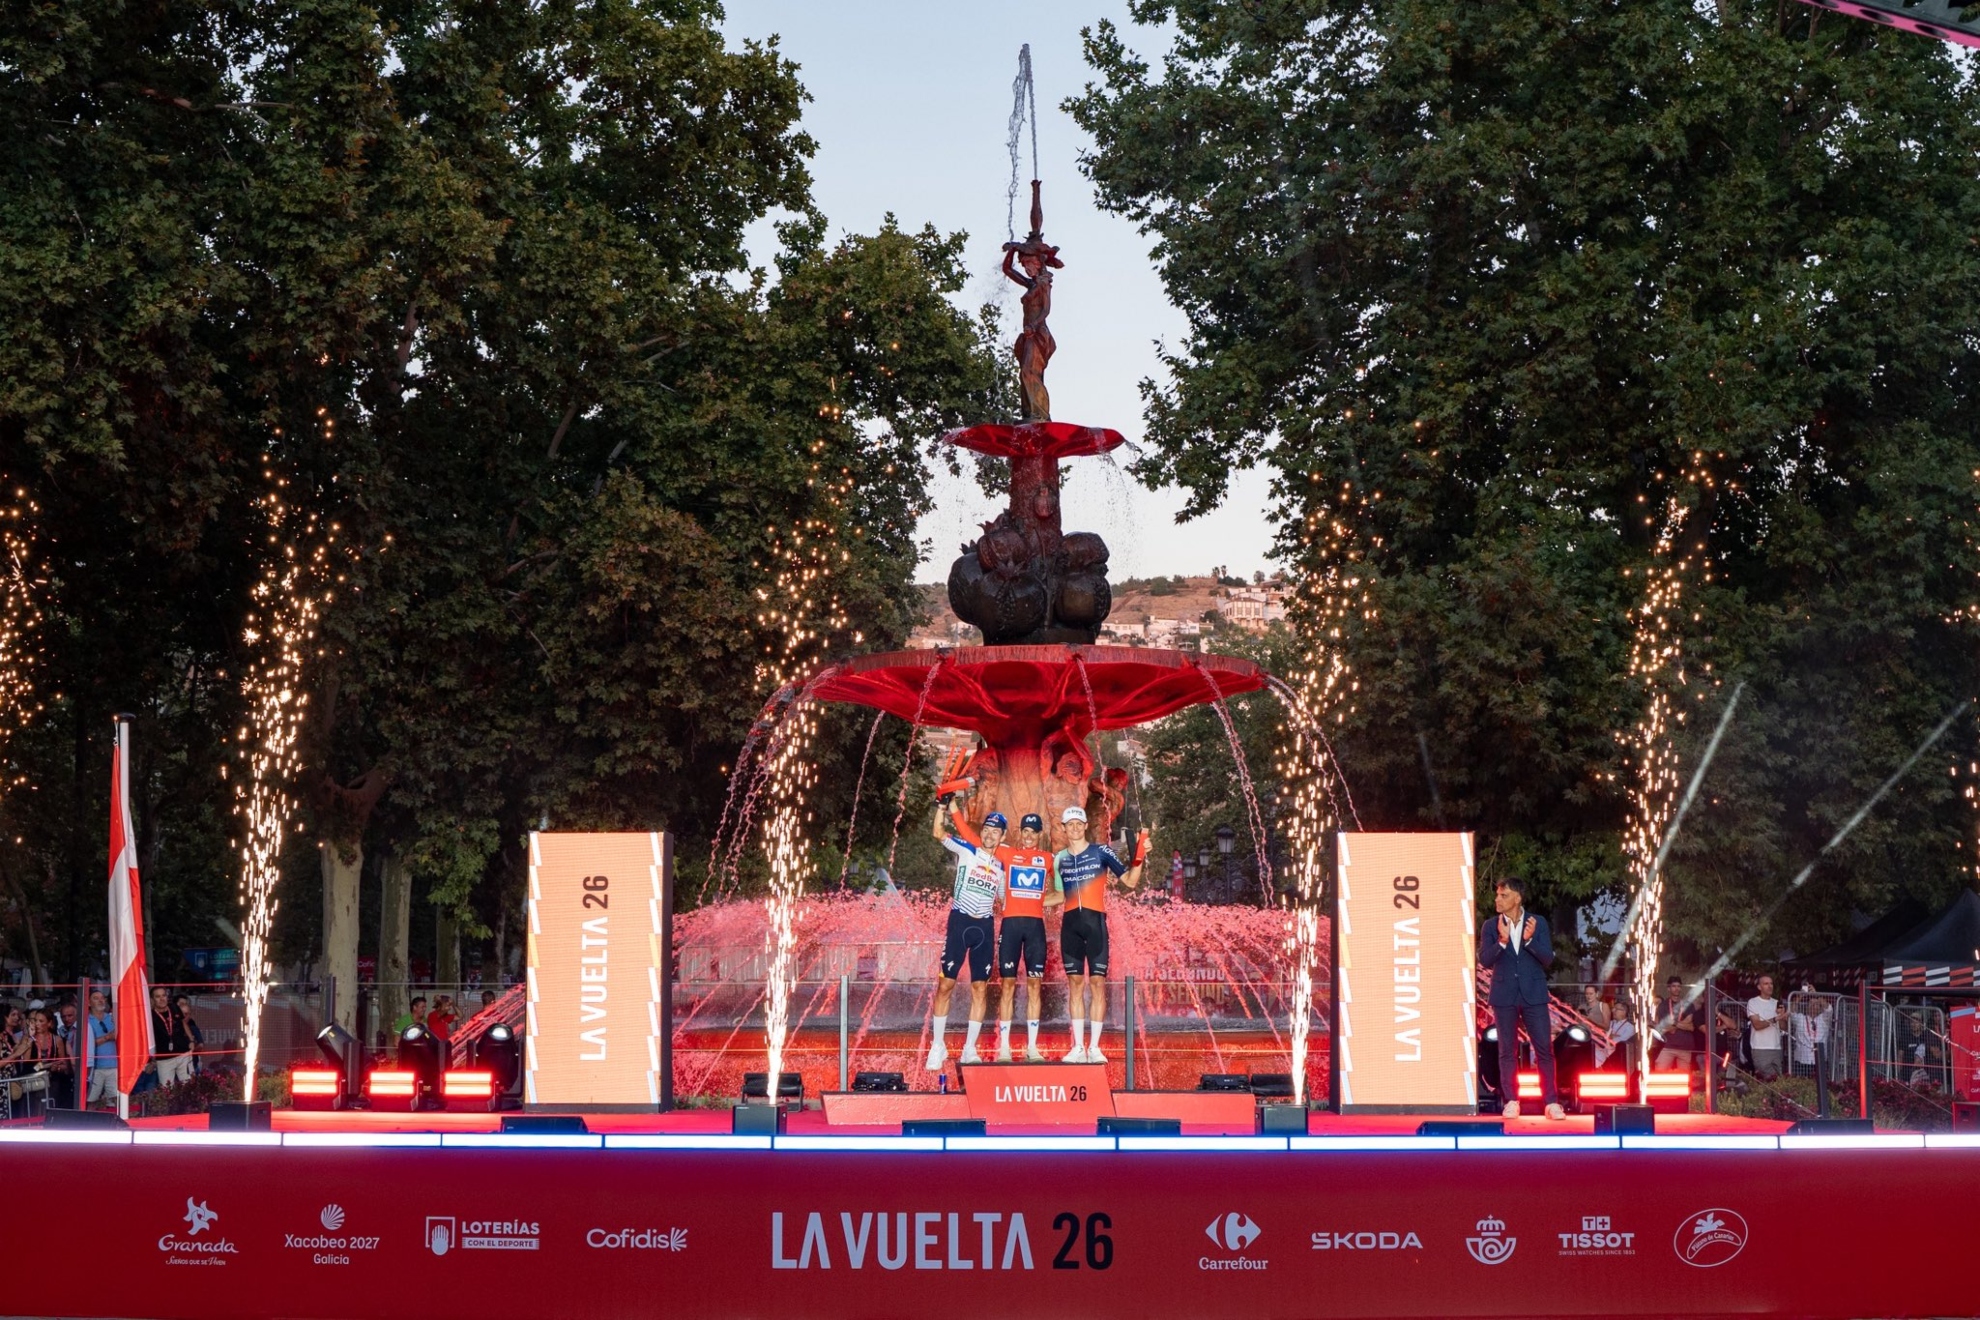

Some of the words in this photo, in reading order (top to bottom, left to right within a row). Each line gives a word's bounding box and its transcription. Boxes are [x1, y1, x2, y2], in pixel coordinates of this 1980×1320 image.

[582, 875, 609, 910] 26
[968, 876, 997, 890] BORA
[1393, 875, 1420, 910] 26
[579, 916, 609, 1023] VUELTA
[1393, 916, 1422, 1024] VUELTA
[579, 1027, 607, 1061] LA
[1394, 1027, 1422, 1062] LA
[995, 1085, 1012, 1102] LA
[1014, 1085, 1067, 1102] VUELTA
[1070, 1085, 1087, 1102] 26
[461, 1219, 540, 1236] LOTERÍAS
[158, 1233, 239, 1253] Granada
[285, 1233, 347, 1249] Xacobeo
[349, 1236, 380, 1249] 2027
[498, 1240, 534, 1248] DEPORTE
[586, 1228, 670, 1249] Cofidis
[772, 1212, 831, 1269] LA
[841, 1212, 1034, 1270] VUELTA
[1052, 1212, 1114, 1270] 26
[1558, 1232, 1635, 1248] TISSOT
[313, 1253, 350, 1265] Galicia
[1198, 1257, 1269, 1270] Carrefour
